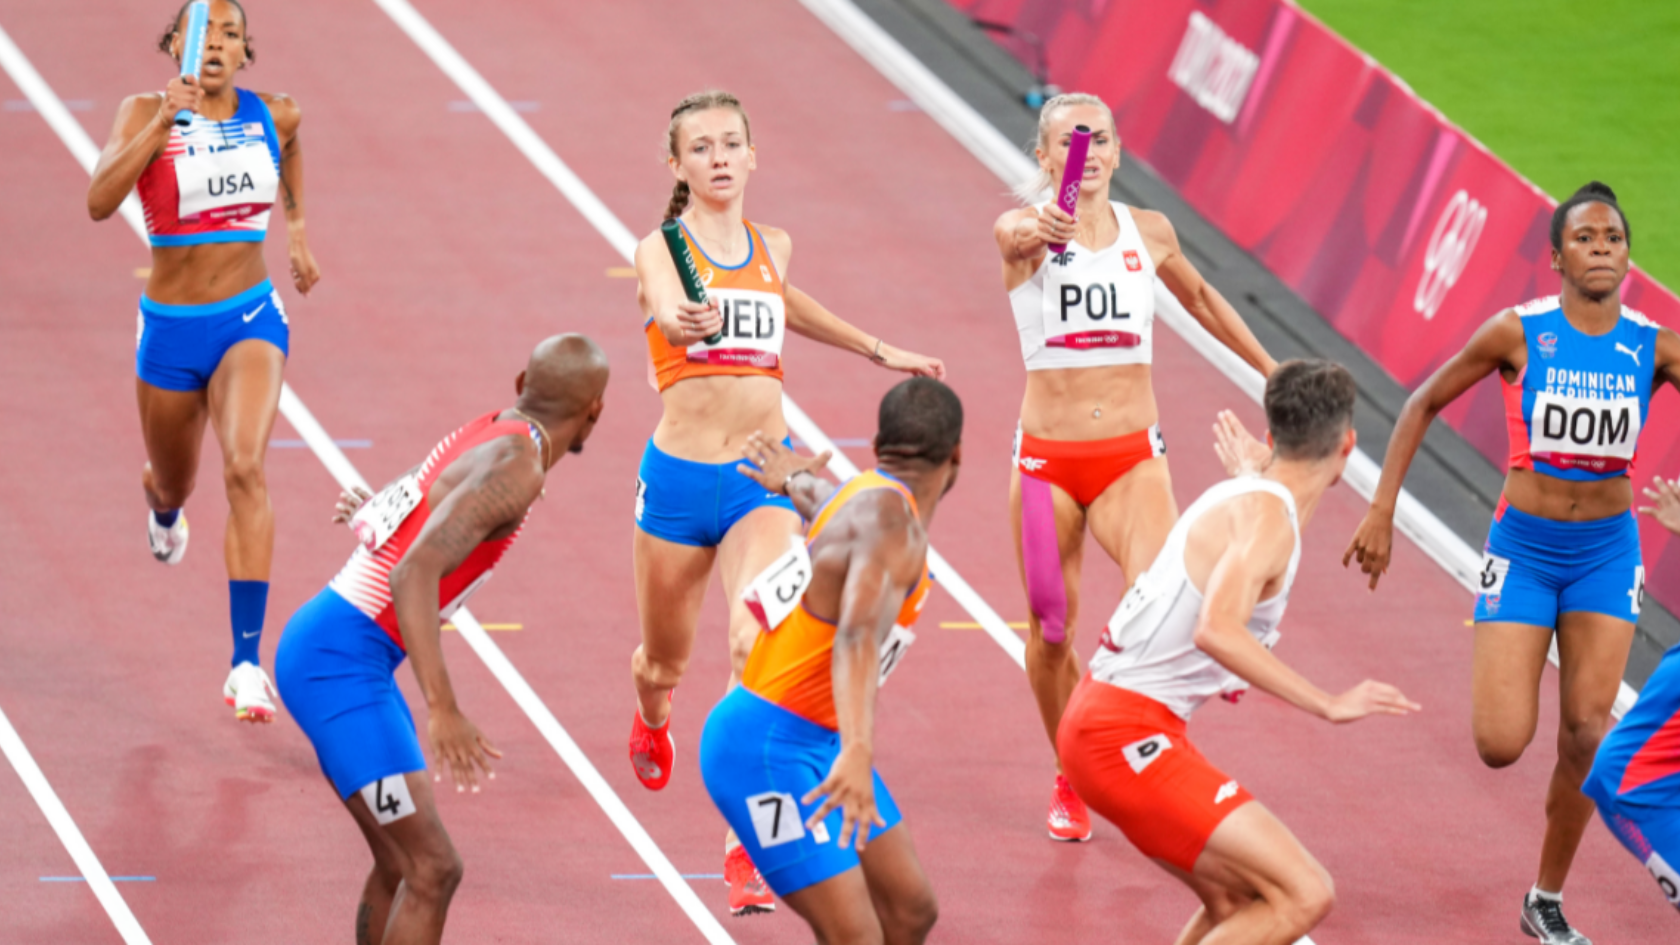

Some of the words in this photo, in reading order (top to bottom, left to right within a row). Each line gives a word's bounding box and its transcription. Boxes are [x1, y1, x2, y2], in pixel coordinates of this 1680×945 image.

[208, 172, 255, 198] USA
[1051, 251, 1076, 267] 4F
[1060, 283, 1131, 322] POL
[1546, 367, 1636, 393] DOMINICAN
[1543, 403, 1630, 446] DOM
[767, 555, 805, 604] 13
[376, 778, 401, 816] 4
[758, 796, 783, 840] 7
